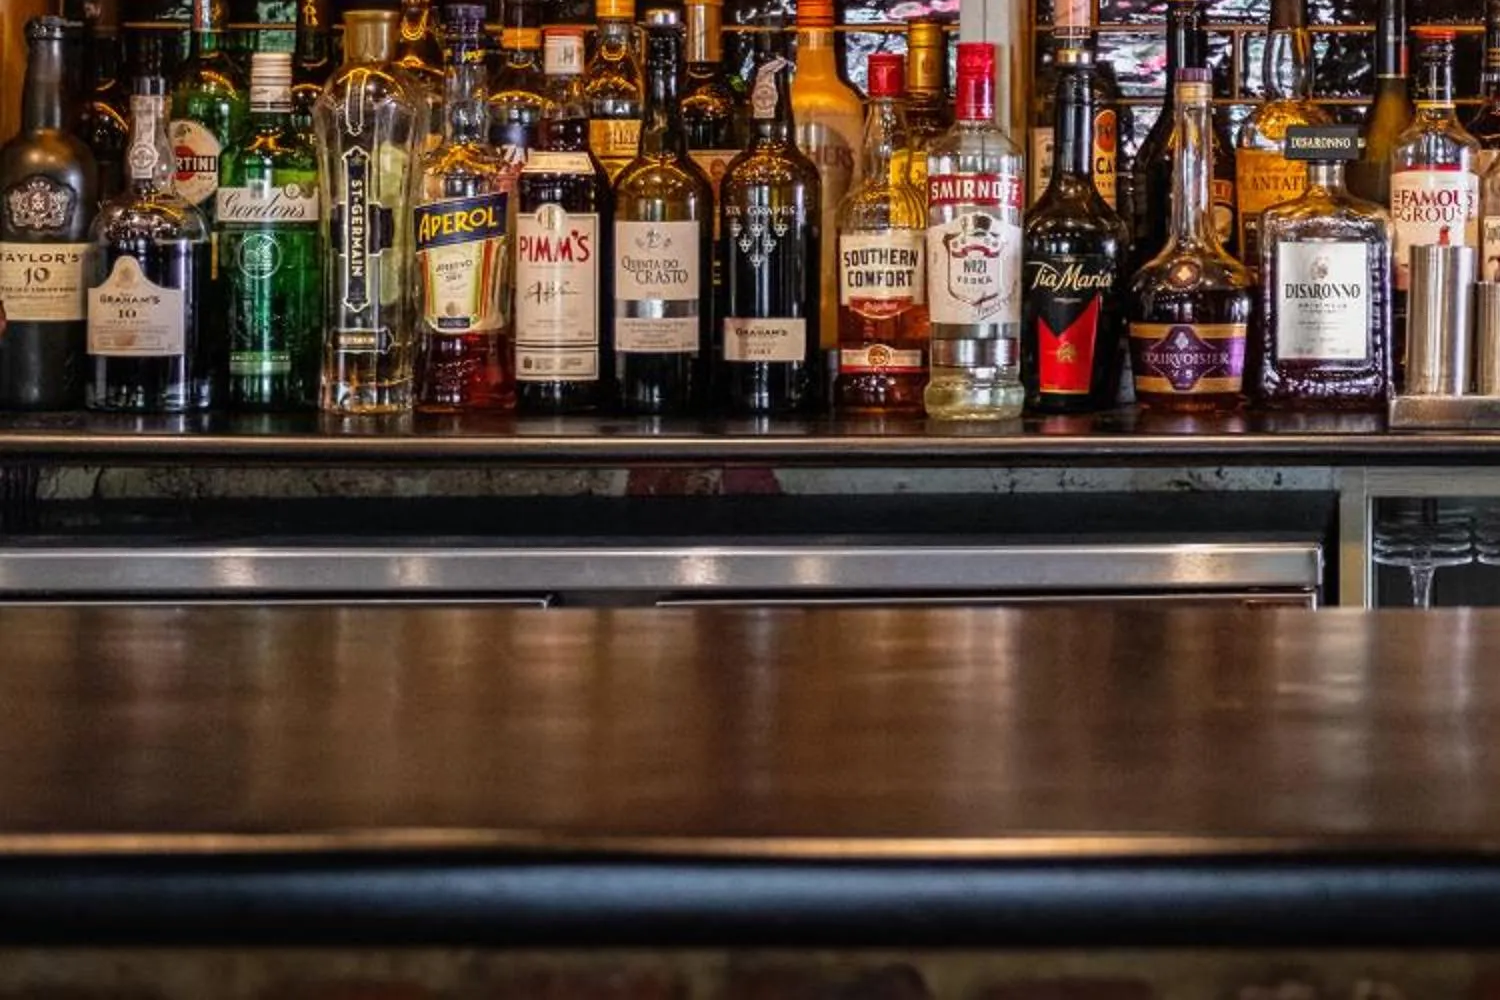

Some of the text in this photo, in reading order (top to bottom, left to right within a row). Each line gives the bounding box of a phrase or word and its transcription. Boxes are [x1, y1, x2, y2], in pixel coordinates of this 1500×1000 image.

[1290, 136, 1351, 150] DISARONNO
[177, 155, 216, 172] RTINI
[417, 207, 498, 243] APEROL
[519, 230, 590, 263] PIMM'S
[843, 247, 919, 269] SOUTHERN
[23, 266, 51, 286] 10
[635, 270, 689, 286] CRASTO
[847, 269, 915, 289] COMFORT
[1031, 262, 1114, 290] Tia Maria
[1285, 282, 1361, 301] DISARONNO
